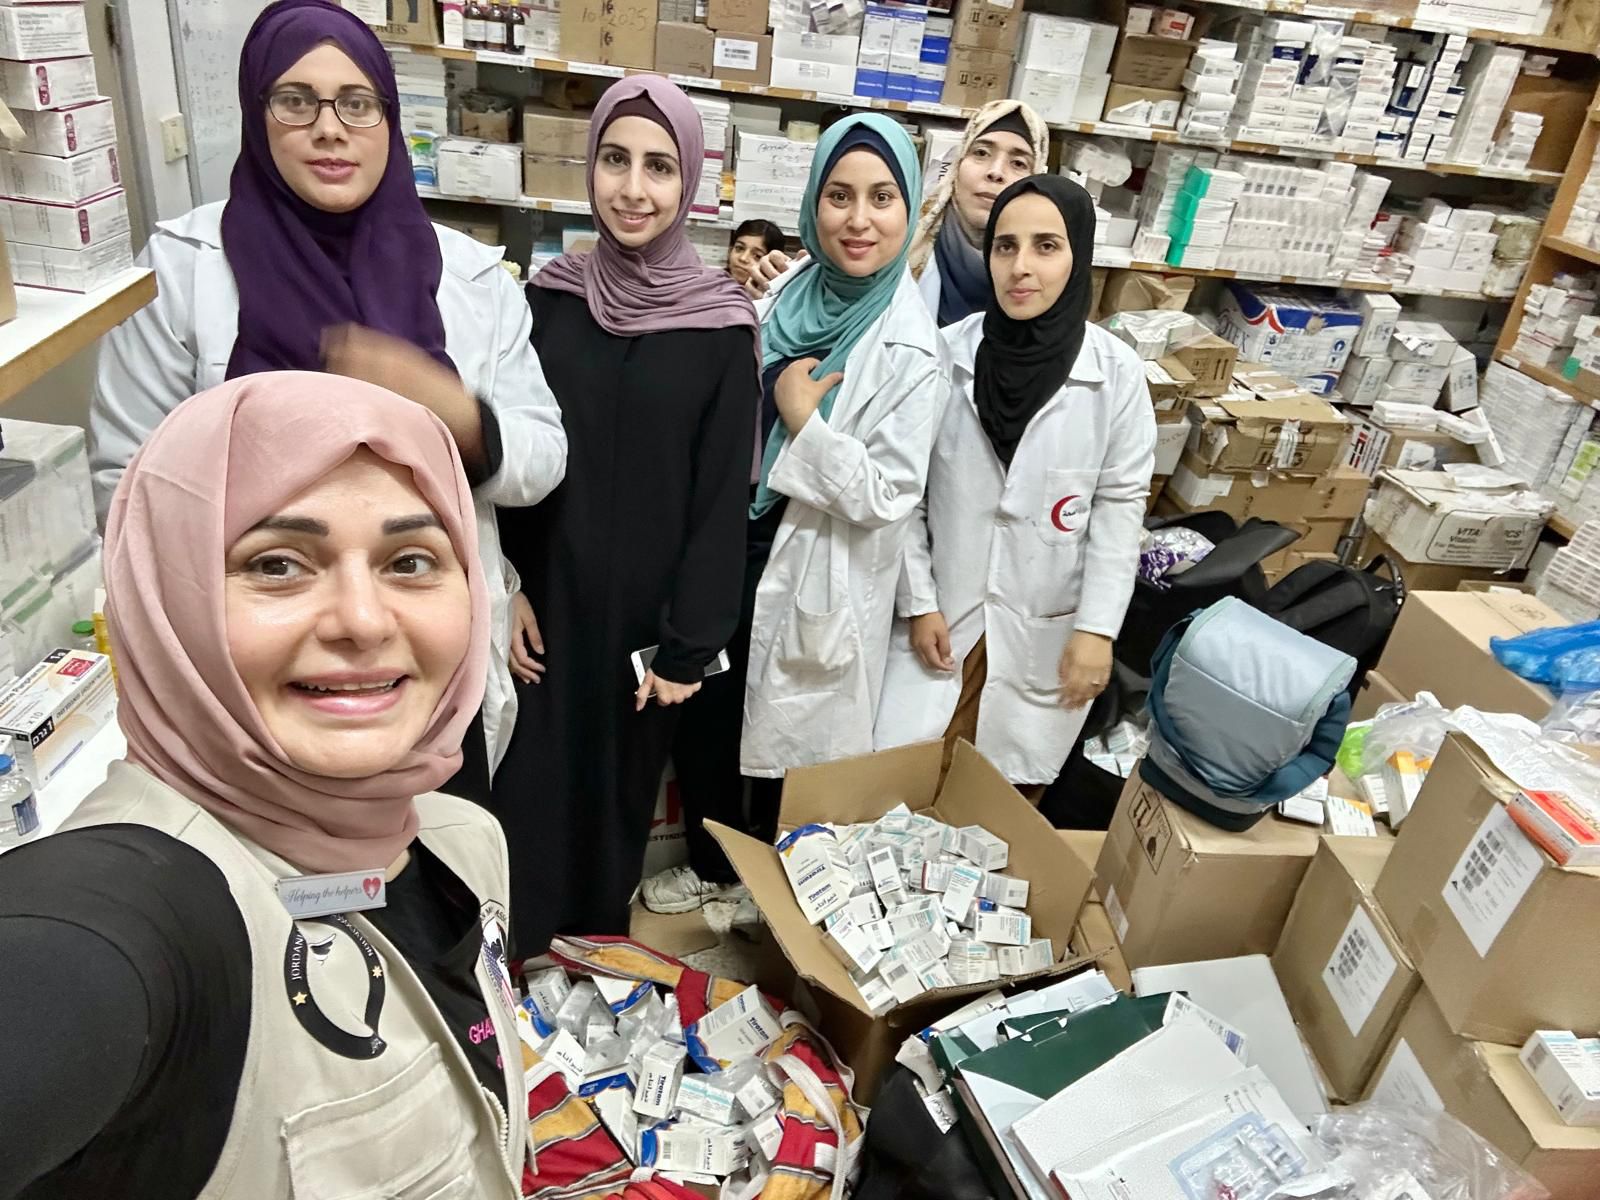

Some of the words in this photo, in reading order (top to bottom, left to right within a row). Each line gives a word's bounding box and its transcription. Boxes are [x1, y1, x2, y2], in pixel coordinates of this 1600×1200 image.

[286, 888, 321, 907] Helping
[322, 887, 335, 898] the
[335, 884, 363, 900] helpers
[808, 883, 832, 901] Tirotam
[749, 1017, 770, 1041] Tirotam
[655, 1075, 667, 1106] Tirotam
